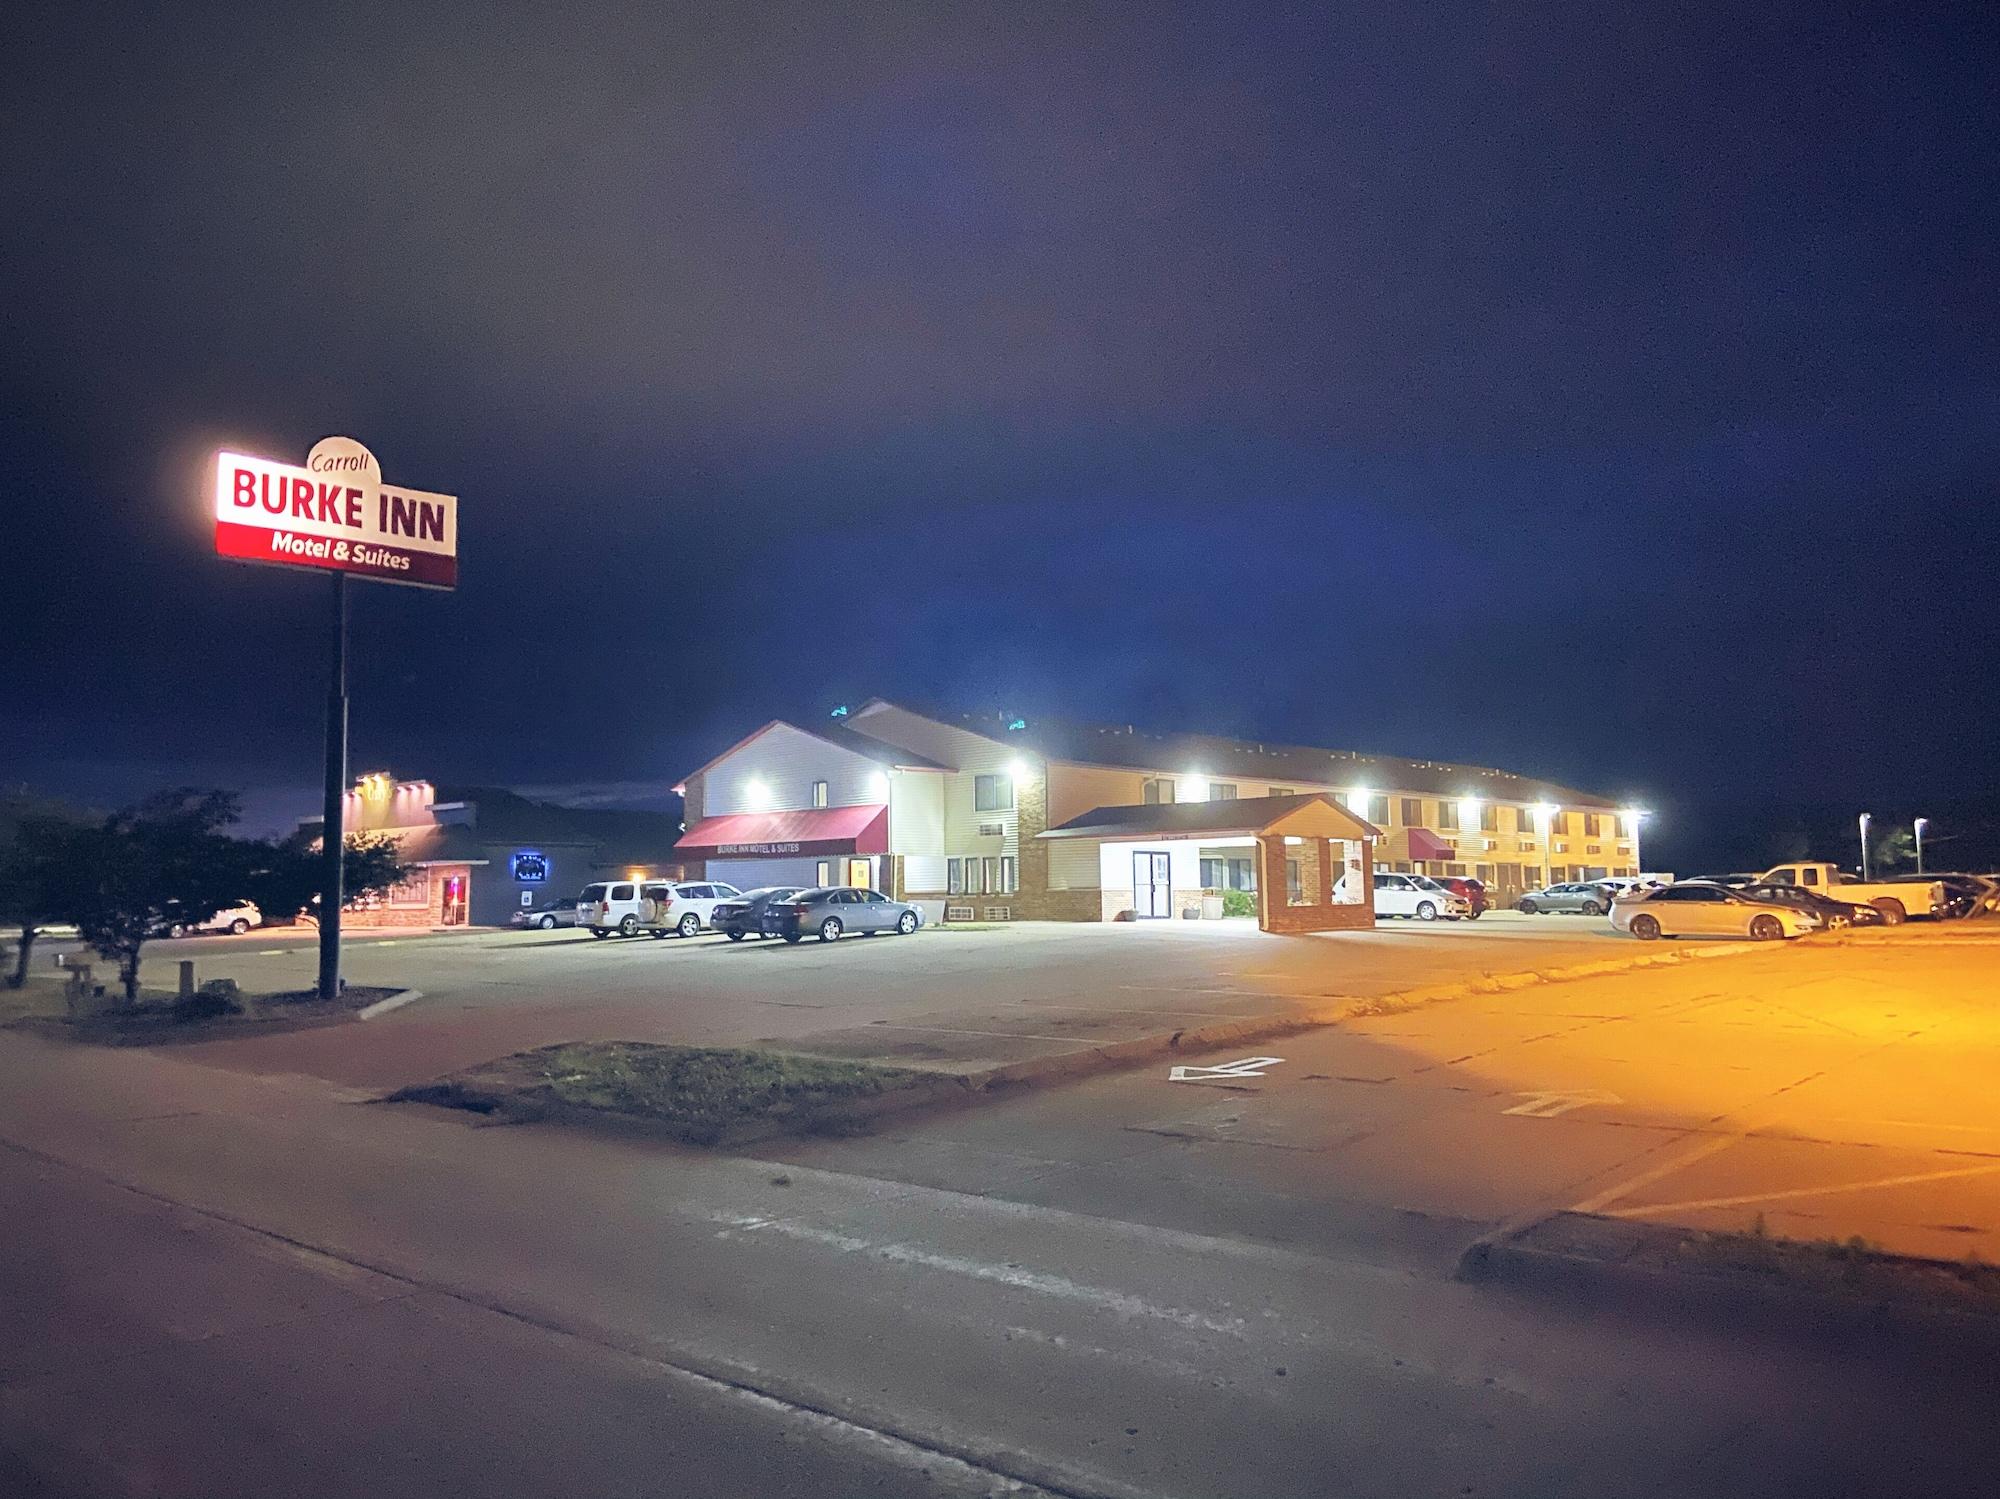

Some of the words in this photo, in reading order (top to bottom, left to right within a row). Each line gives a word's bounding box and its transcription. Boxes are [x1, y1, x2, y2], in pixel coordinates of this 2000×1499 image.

[311, 453, 369, 473] Carroll
[233, 468, 364, 529] BURKE
[379, 493, 445, 542] INN
[271, 531, 331, 559] Motel
[332, 540, 351, 561] &
[352, 545, 411, 570] Suites
[717, 845, 738, 854] BURKE
[750, 844, 770, 853] MOTEL
[777, 843, 799, 853] SUITES
